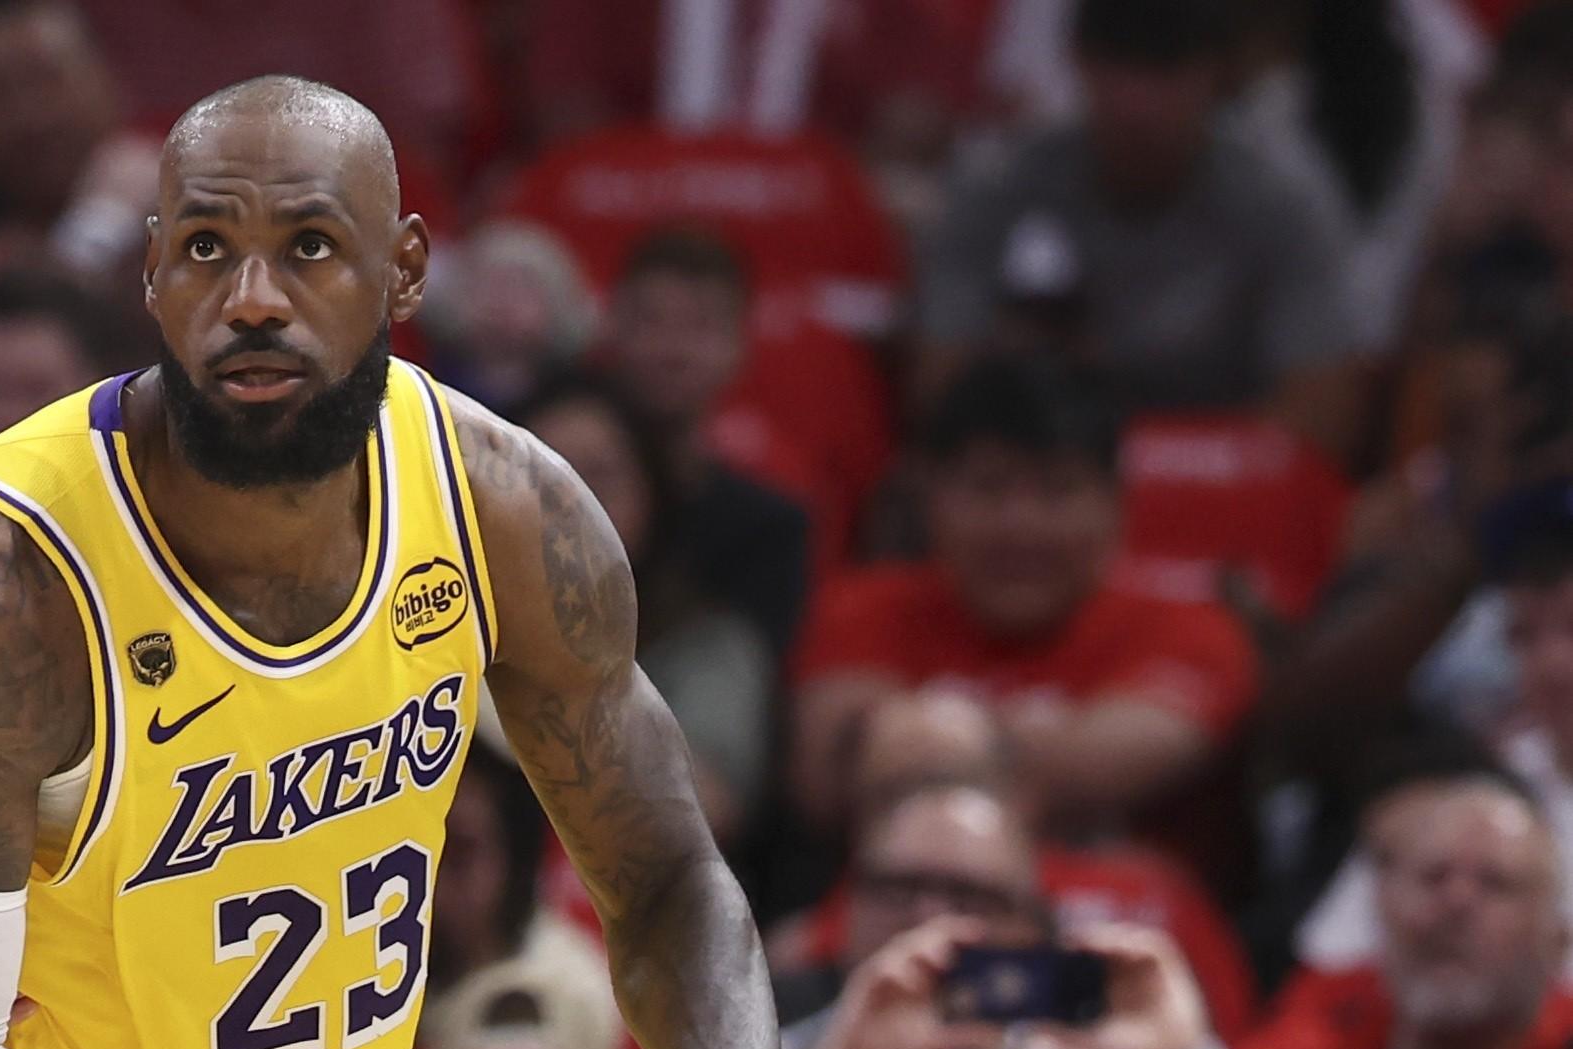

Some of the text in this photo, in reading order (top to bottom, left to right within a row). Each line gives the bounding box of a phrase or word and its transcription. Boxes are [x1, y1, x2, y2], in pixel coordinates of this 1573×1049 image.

[394, 580, 463, 627] bibigo
[405, 609, 436, 633] 비비고
[117, 672, 467, 898] LAKERS
